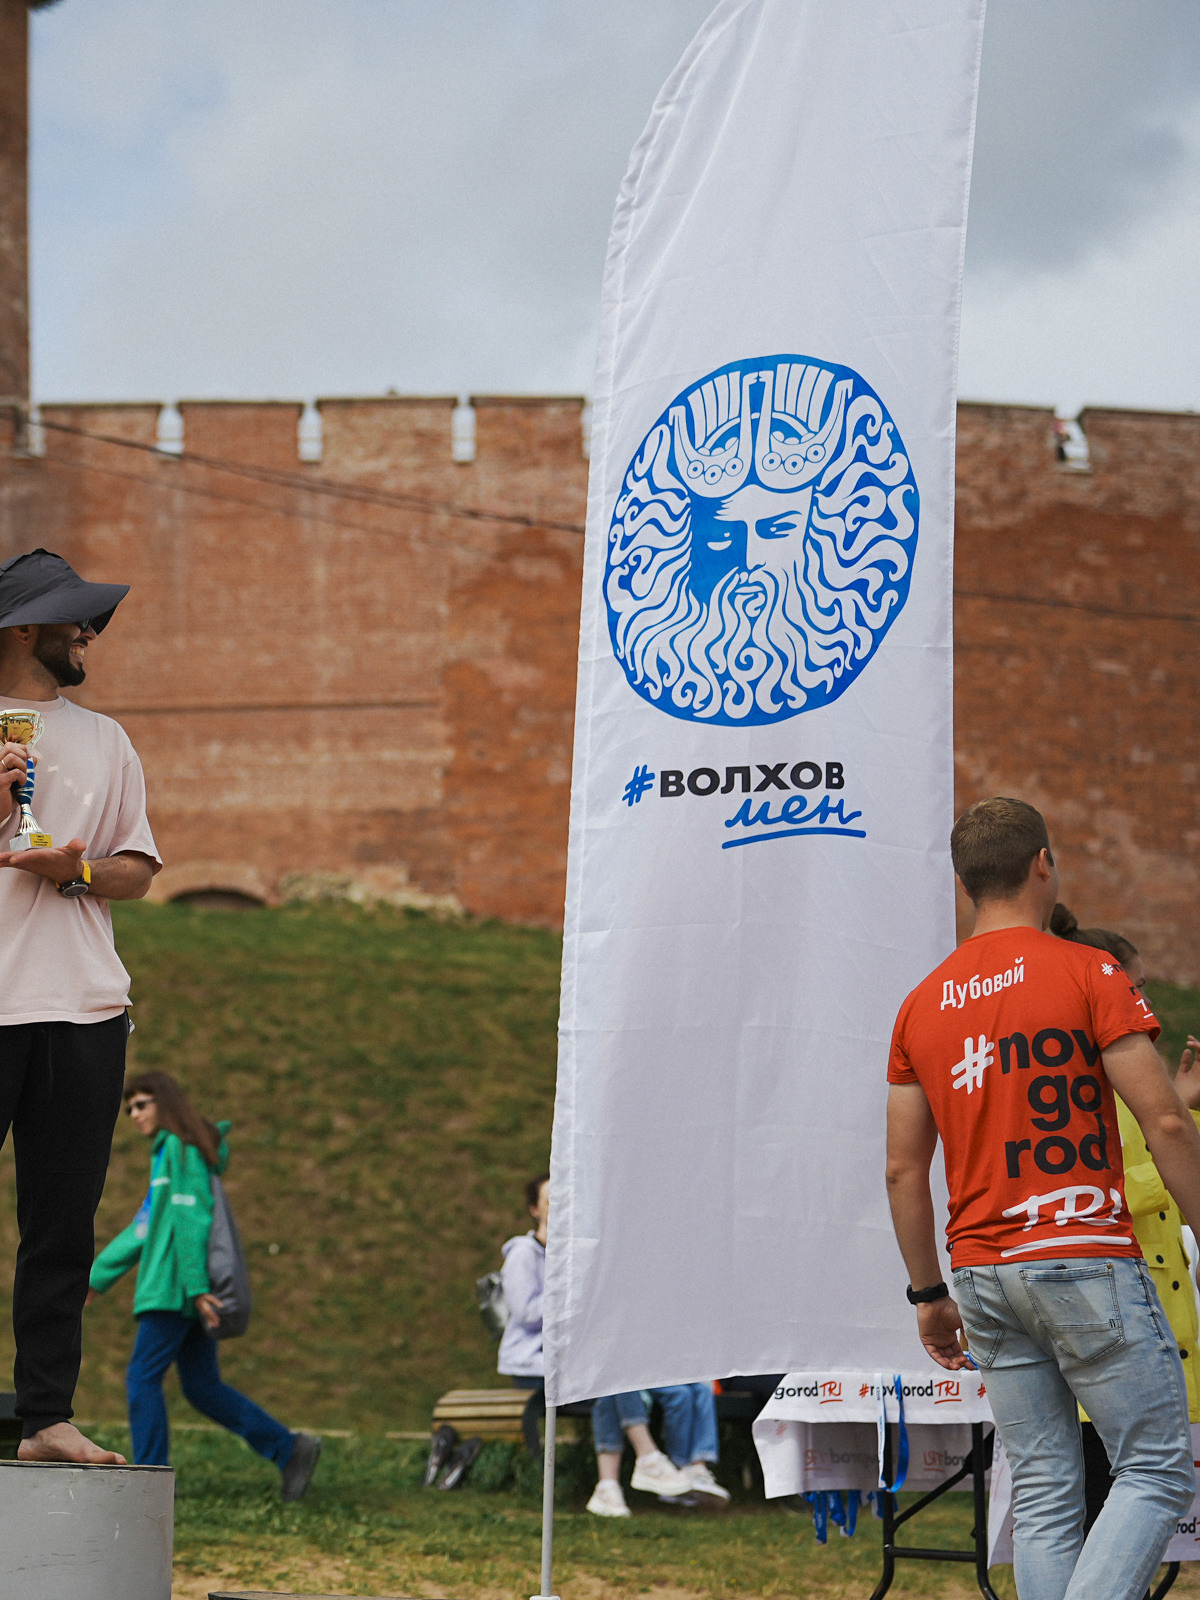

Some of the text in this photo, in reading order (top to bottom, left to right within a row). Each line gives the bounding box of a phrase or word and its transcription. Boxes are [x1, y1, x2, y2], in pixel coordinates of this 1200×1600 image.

[622, 761, 845, 807] #ВОЛХОВ
[725, 795, 862, 828] мен
[940, 956, 1025, 1010] Дубовой
[951, 1027, 1102, 1095] #nov
[1027, 1074, 1102, 1132] go
[1004, 1113, 1111, 1178] rod
